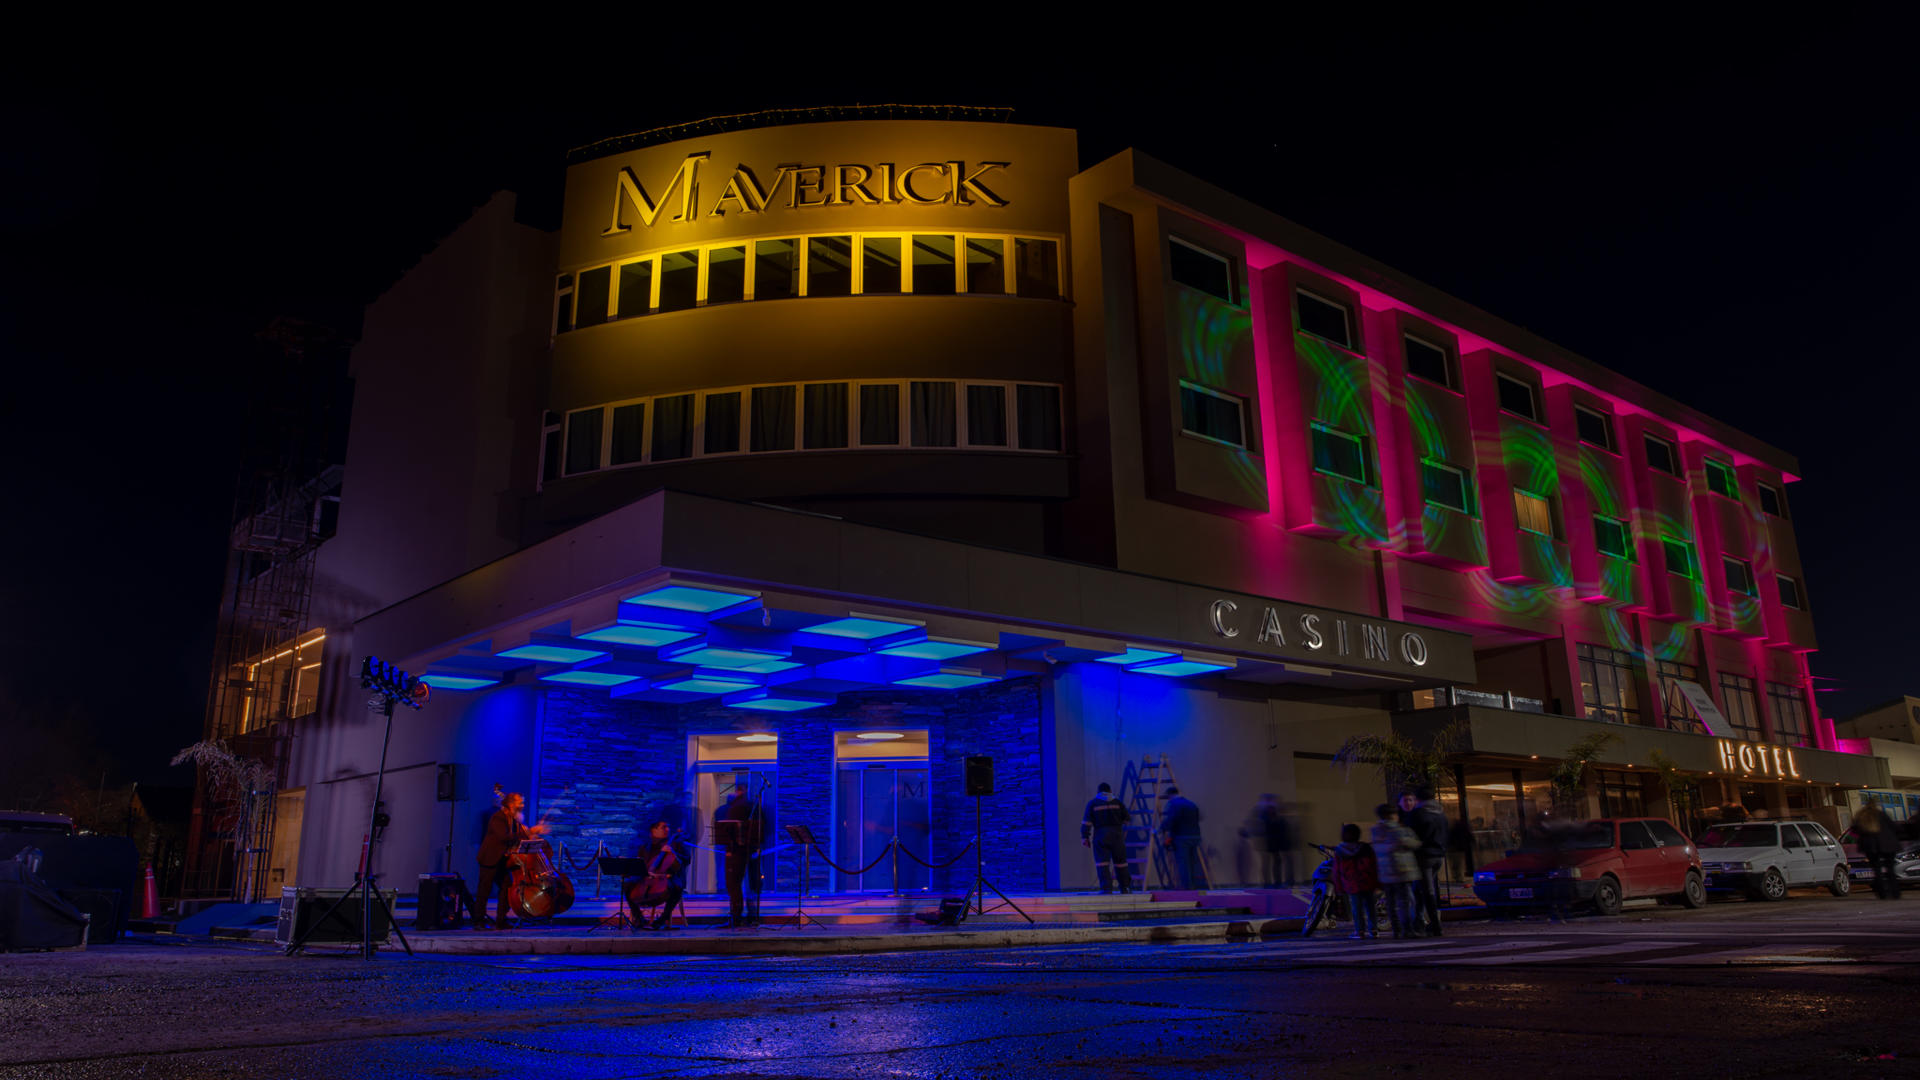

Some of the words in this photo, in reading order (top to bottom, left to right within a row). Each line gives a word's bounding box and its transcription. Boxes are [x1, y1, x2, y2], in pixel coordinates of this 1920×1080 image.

[601, 150, 1011, 237] MAVERICK
[1209, 599, 1429, 667] CASINO
[1718, 739, 1800, 778] HOTEL
[903, 781, 925, 799] M
